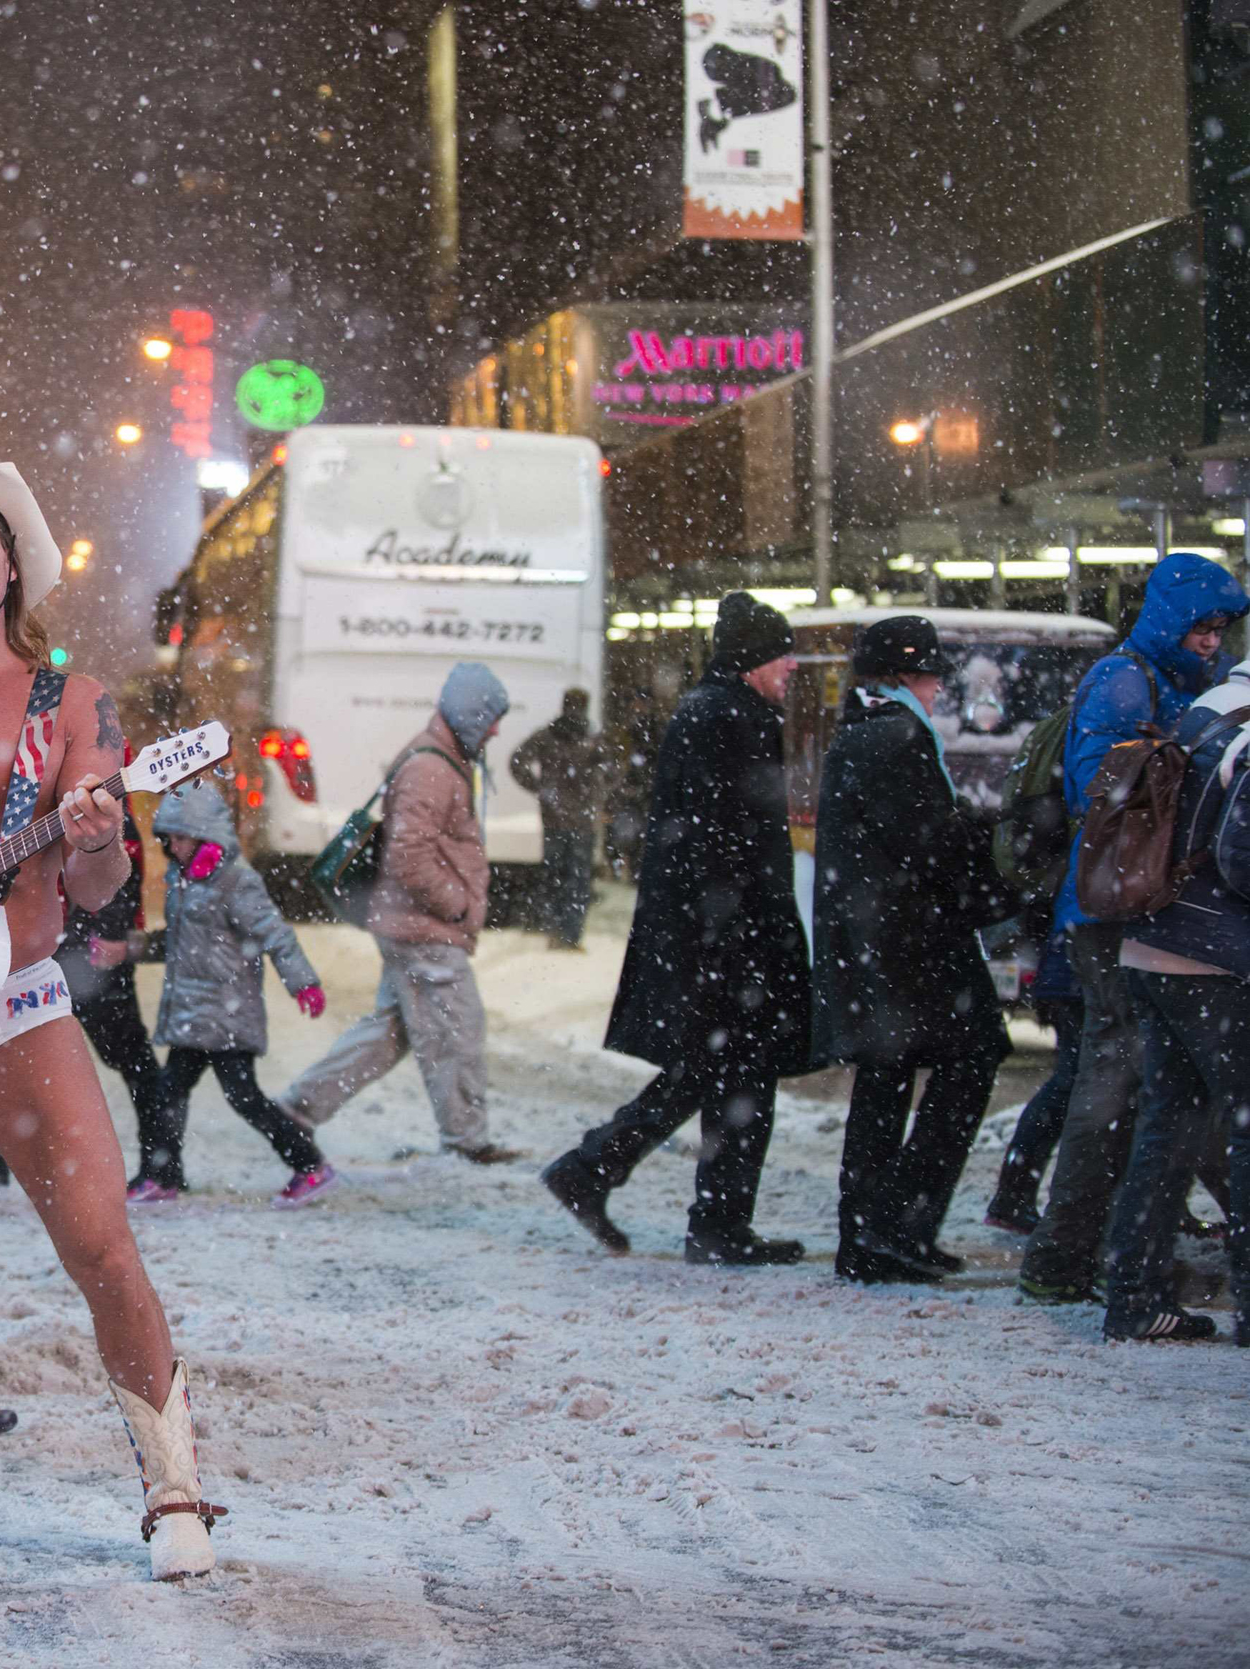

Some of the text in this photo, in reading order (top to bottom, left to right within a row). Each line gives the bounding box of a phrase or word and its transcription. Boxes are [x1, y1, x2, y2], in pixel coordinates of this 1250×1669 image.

[613, 328, 803, 377] Marriott
[651, 382, 716, 406] YORK
[364, 527, 532, 583] Academy
[339, 615, 546, 644] 1-800-442-7272
[149, 741, 203, 775] OYSTERS
